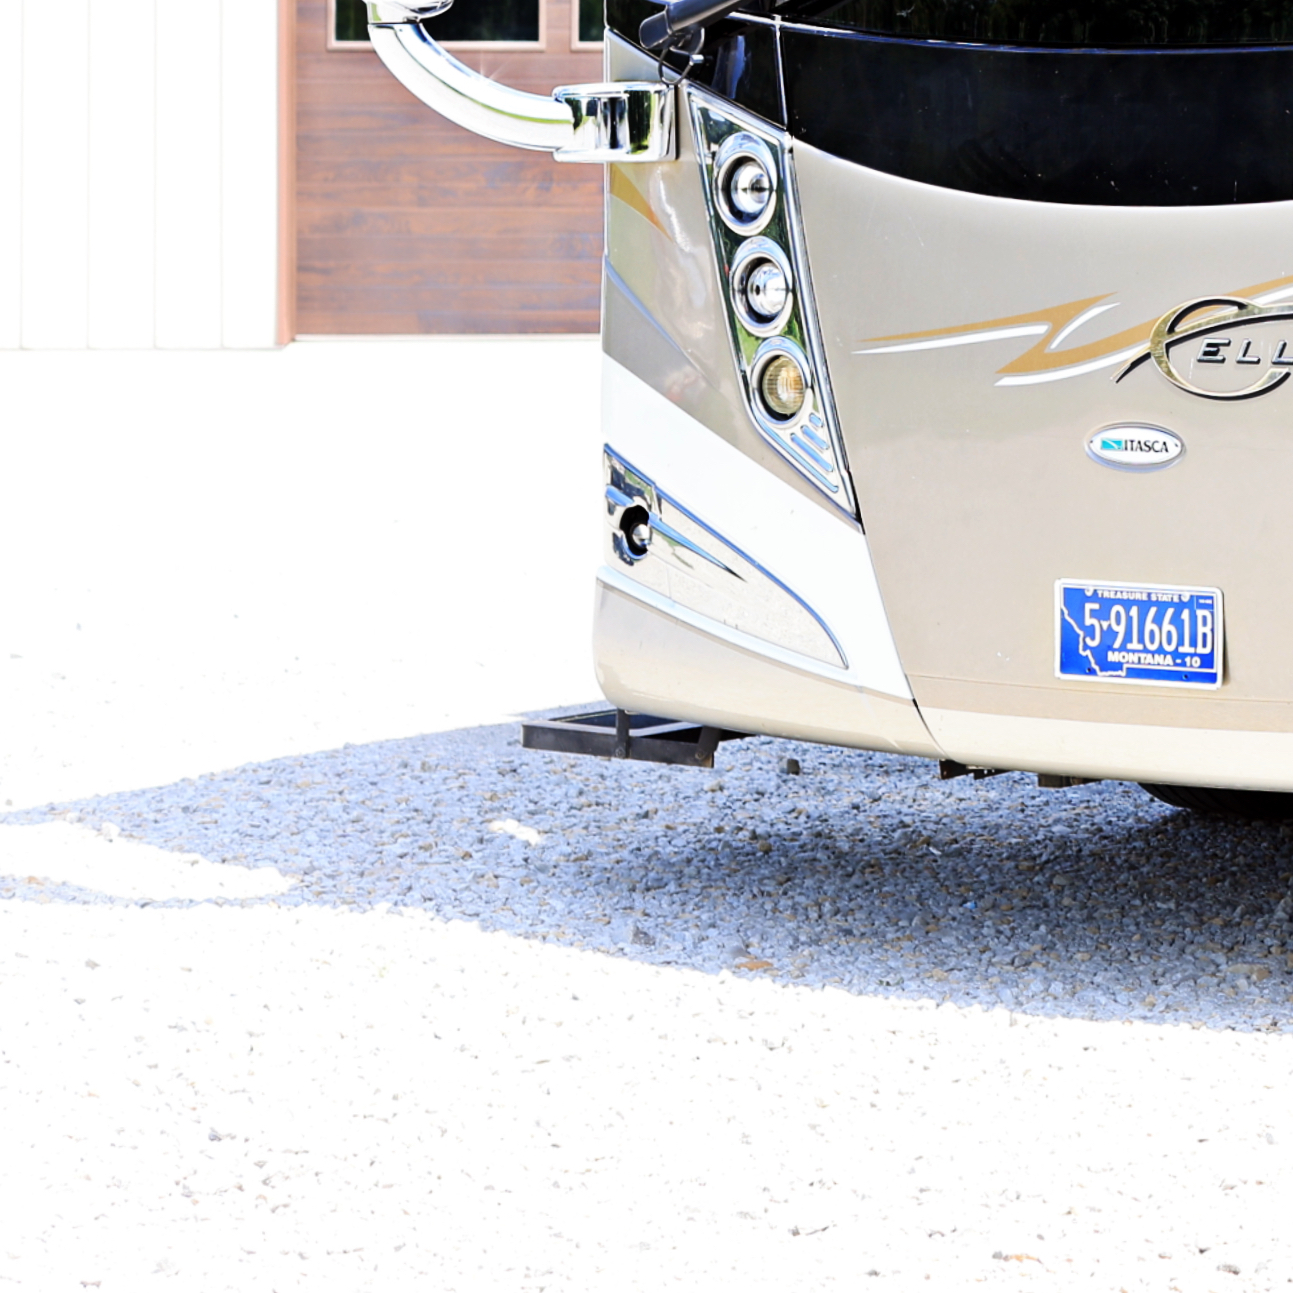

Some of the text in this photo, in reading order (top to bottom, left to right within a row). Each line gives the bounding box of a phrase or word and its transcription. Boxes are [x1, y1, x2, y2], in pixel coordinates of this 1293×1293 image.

[1122, 437, 1170, 455] ITASCA
[1097, 589, 1180, 603] TREASURE STATE
[1107, 650, 1174, 666] MONTANA
[1184, 656, 1201, 668] 10
